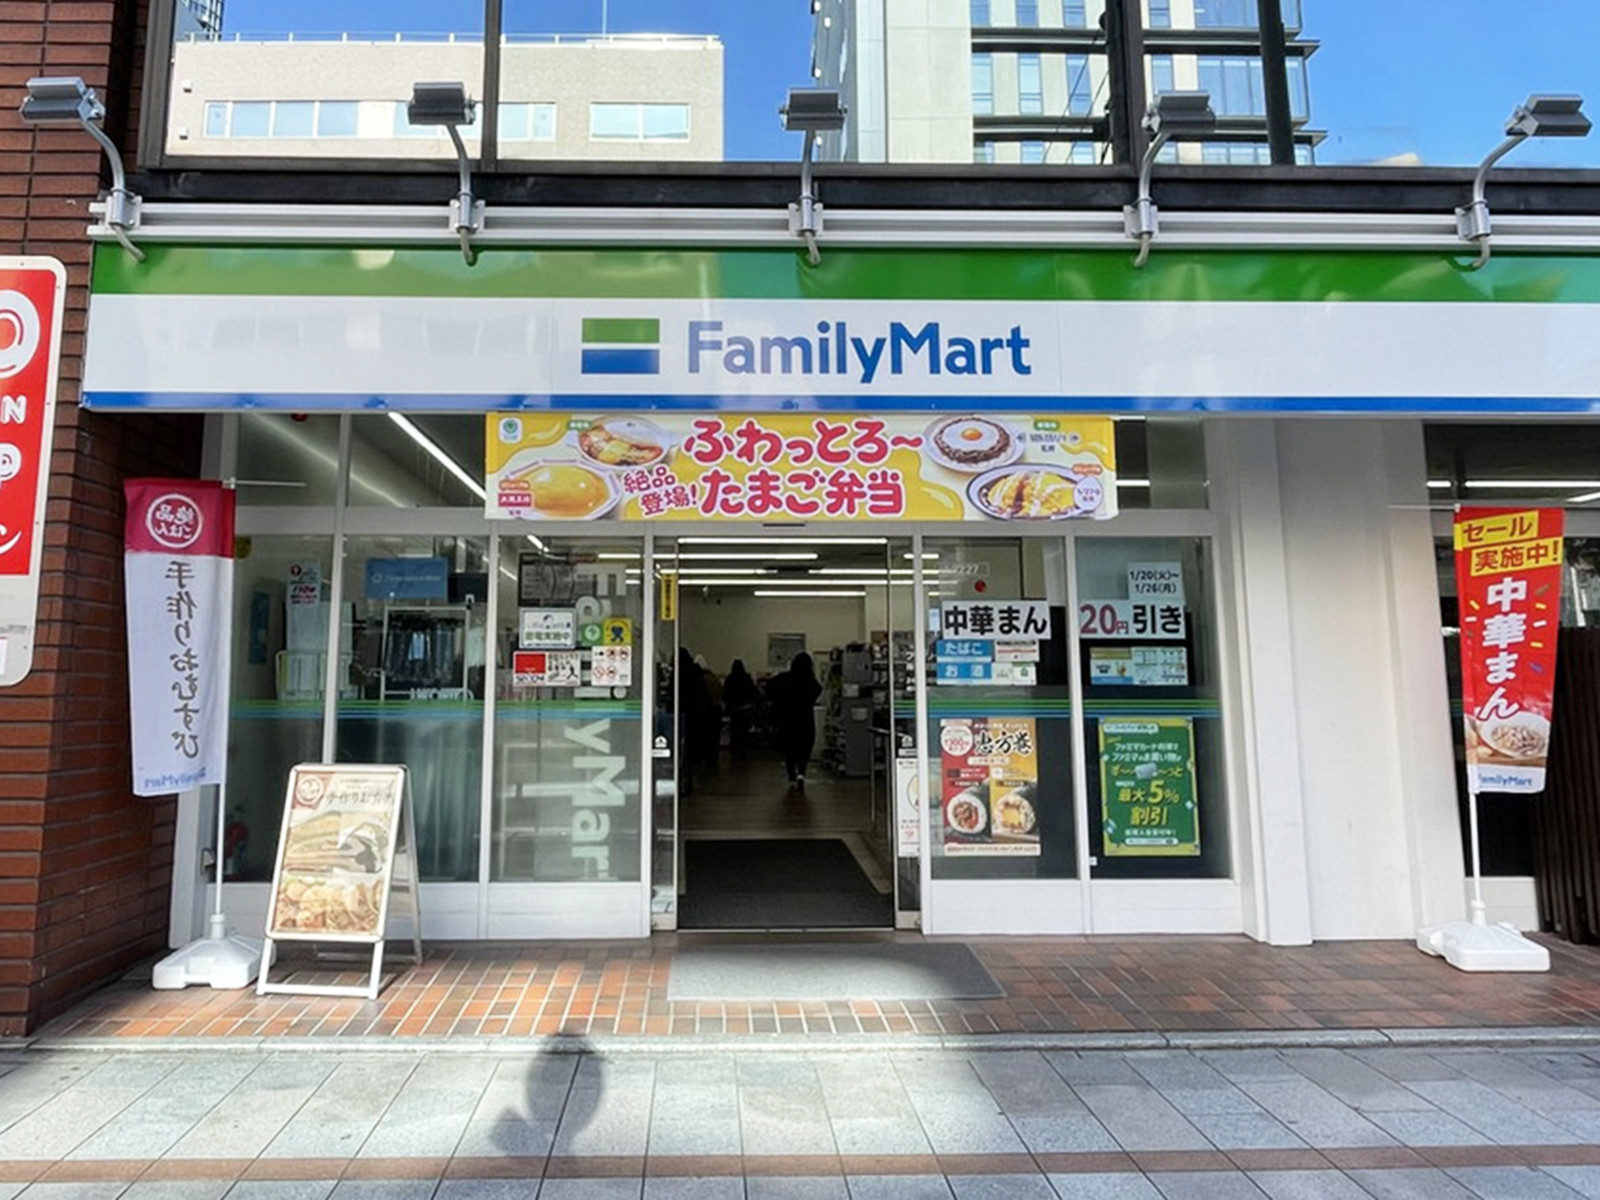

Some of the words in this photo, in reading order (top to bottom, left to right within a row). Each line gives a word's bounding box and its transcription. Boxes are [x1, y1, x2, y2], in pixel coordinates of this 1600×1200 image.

[688, 320, 1032, 384] FamilyMart
[623, 466, 676, 494] 絶品
[701, 468, 902, 514] たまご弁当
[1462, 516, 1533, 543] セール
[944, 605, 1048, 636] 中華まん
[1079, 603, 1182, 635] 20円引き
[945, 642, 983, 655] たばこ
[1479, 577, 1527, 721] 中華まん
